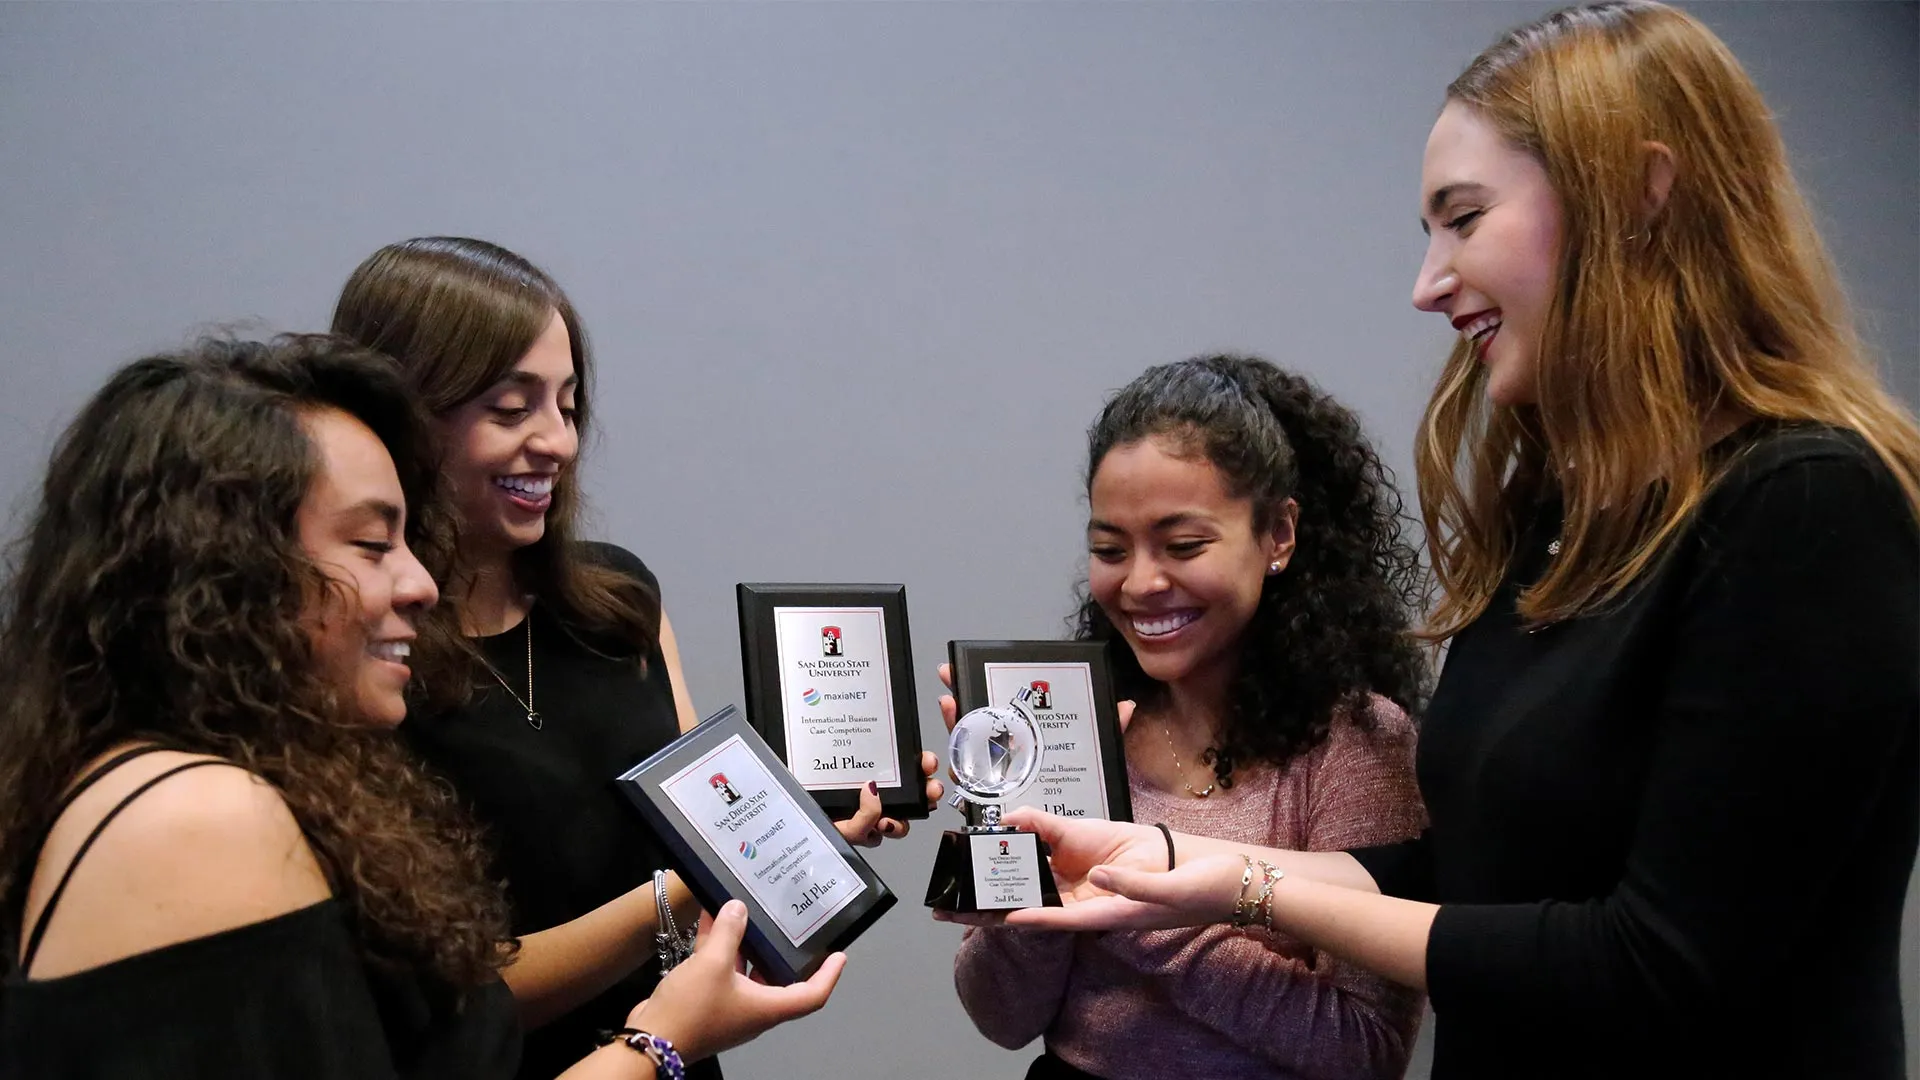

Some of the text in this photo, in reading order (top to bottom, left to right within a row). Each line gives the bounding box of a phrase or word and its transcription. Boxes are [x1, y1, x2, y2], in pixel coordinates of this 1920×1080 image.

[798, 660, 870, 669] SAN DIEGO STATE
[824, 692, 867, 700] maxiaNET
[801, 714, 846, 723] International
[828, 726, 871, 735] Competition
[832, 739, 852, 747] 2019
[813, 756, 874, 770] 2nd Place
[1039, 776, 1081, 784] Competition
[714, 790, 768, 830] SAN DIEGO STATE
[1053, 803, 1085, 816] Place
[728, 802, 767, 832] UNIVERSITY
[755, 819, 786, 846] maxiaNET
[754, 849, 788, 879] International
[768, 850, 812, 884] Case Competition
[791, 870, 807, 884] 2019
[791, 878, 837, 916] 2nd Place
